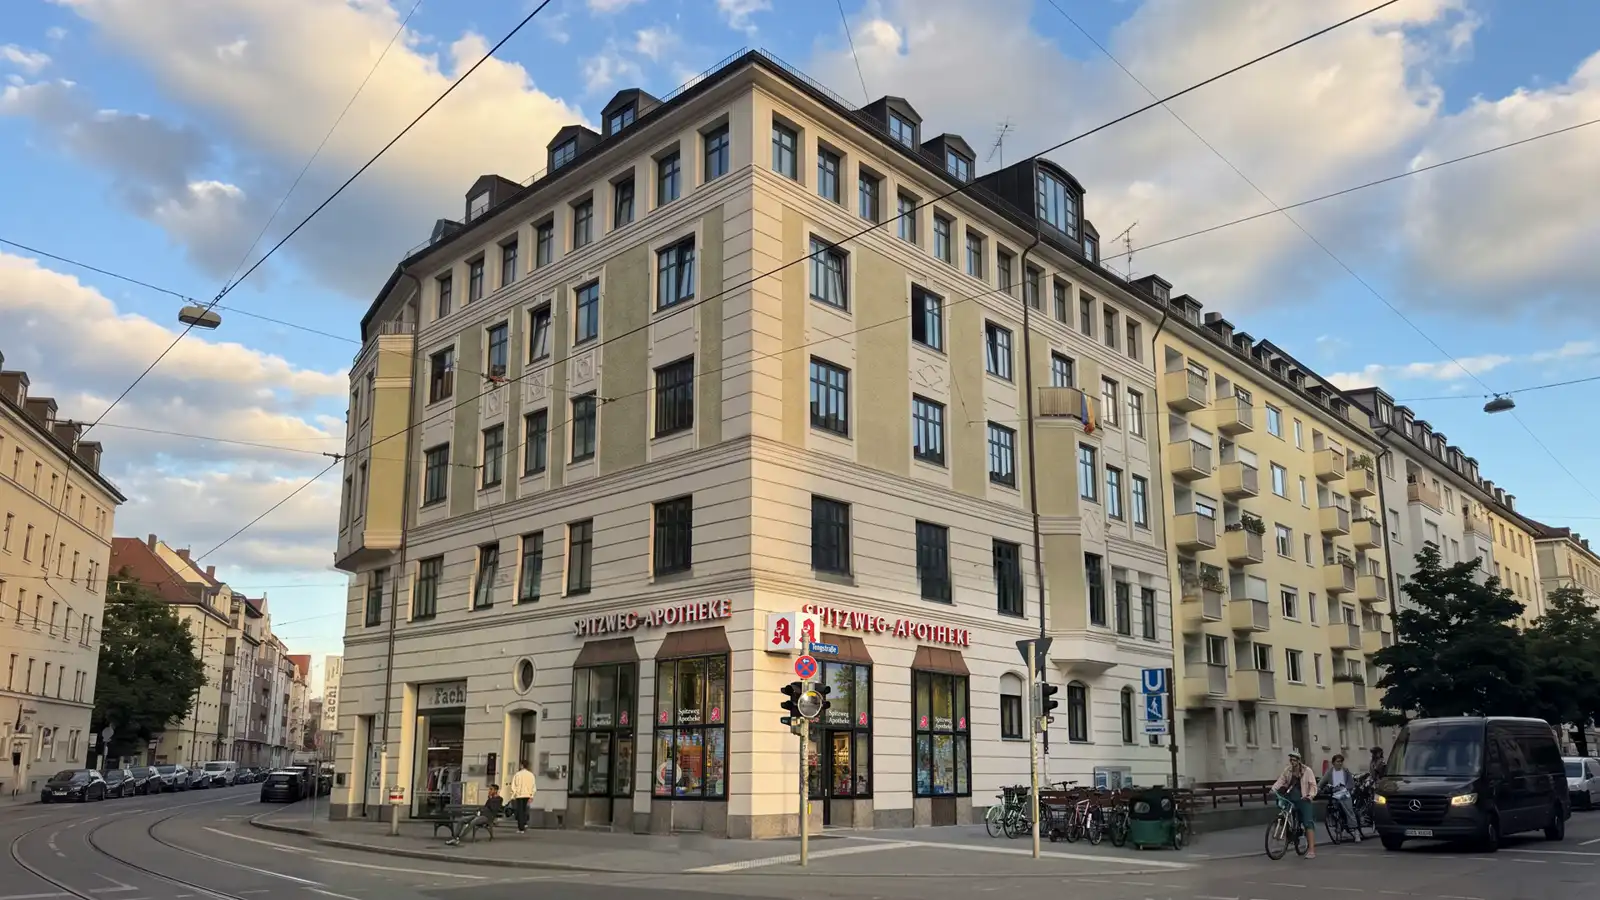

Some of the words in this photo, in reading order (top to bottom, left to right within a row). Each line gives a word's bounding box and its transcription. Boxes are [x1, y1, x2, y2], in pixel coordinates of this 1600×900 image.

[573, 600, 732, 636] SPITZWEG-APOTHEKE
[812, 643, 837, 654] Tengstraße
[1144, 670, 1163, 692] U
